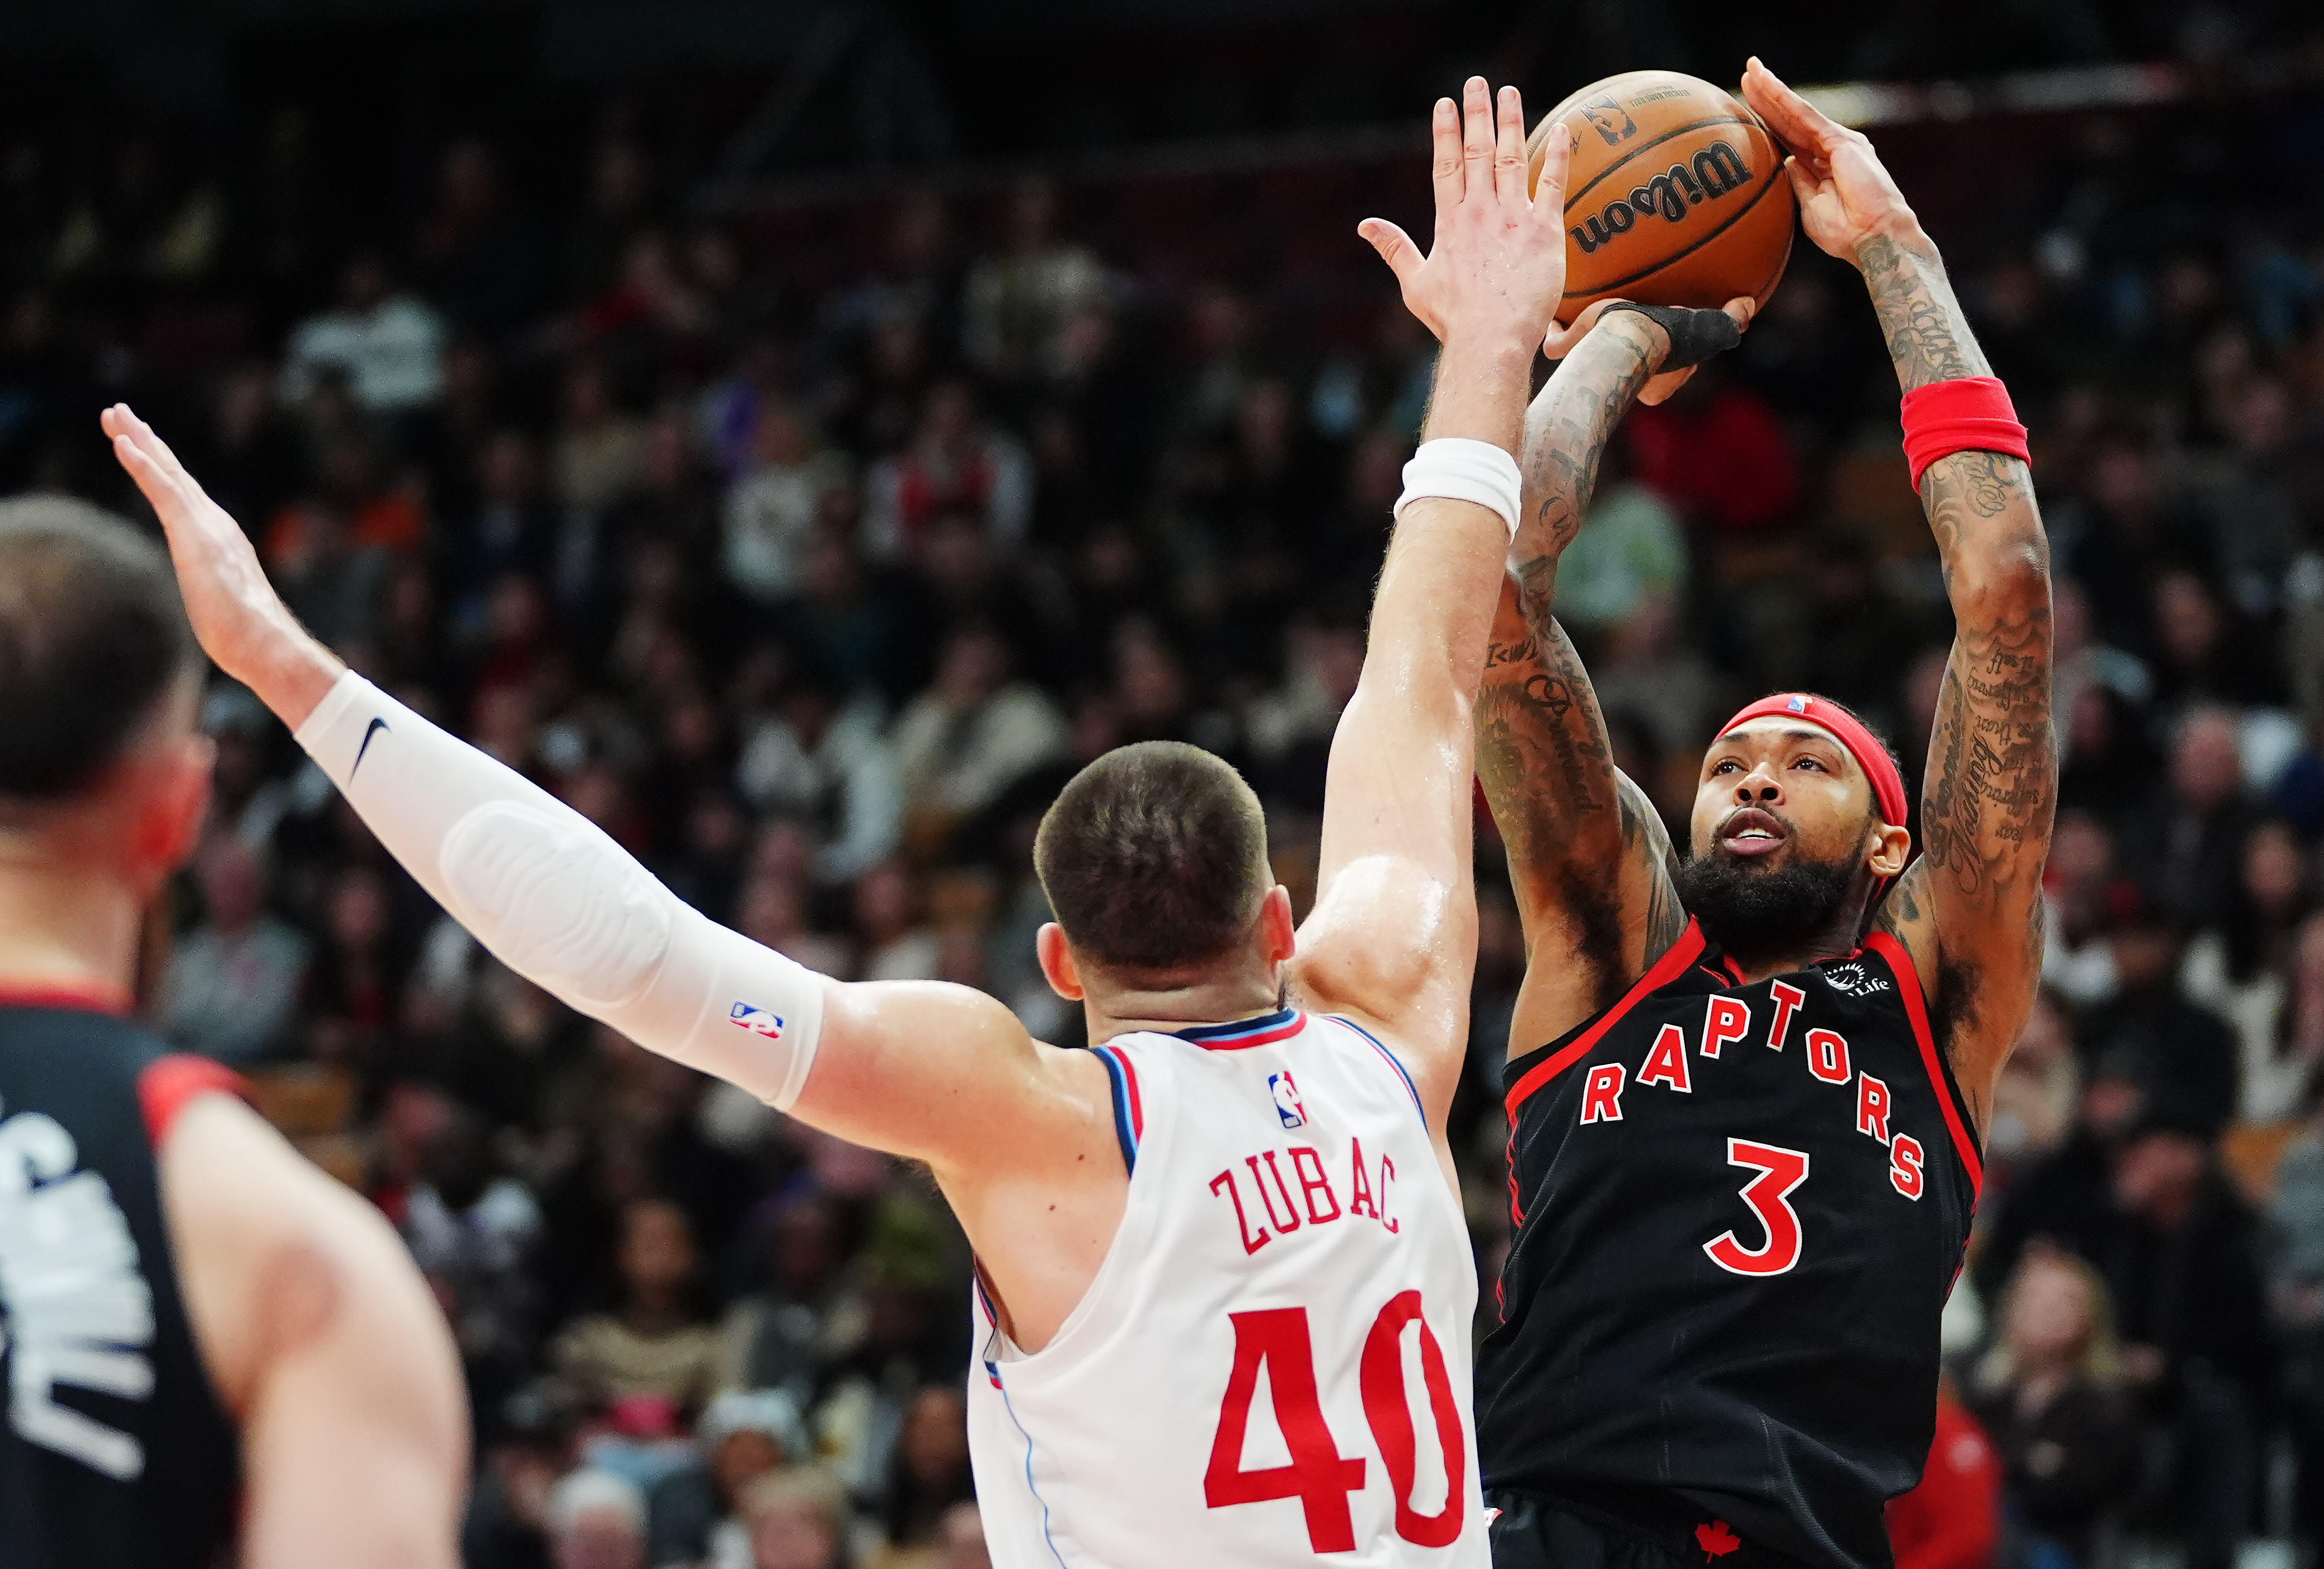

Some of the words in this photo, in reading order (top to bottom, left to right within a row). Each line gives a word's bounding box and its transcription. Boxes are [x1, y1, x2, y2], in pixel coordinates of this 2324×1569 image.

[1569, 140, 1753, 254] Wilson
[1855, 978, 1889, 996] Life
[1580, 979, 1924, 1201] RAPTORS
[1209, 1137, 1399, 1256] ZUBAC
[1702, 1137, 1809, 1276] 3
[1204, 1290, 1465, 1553] 40
